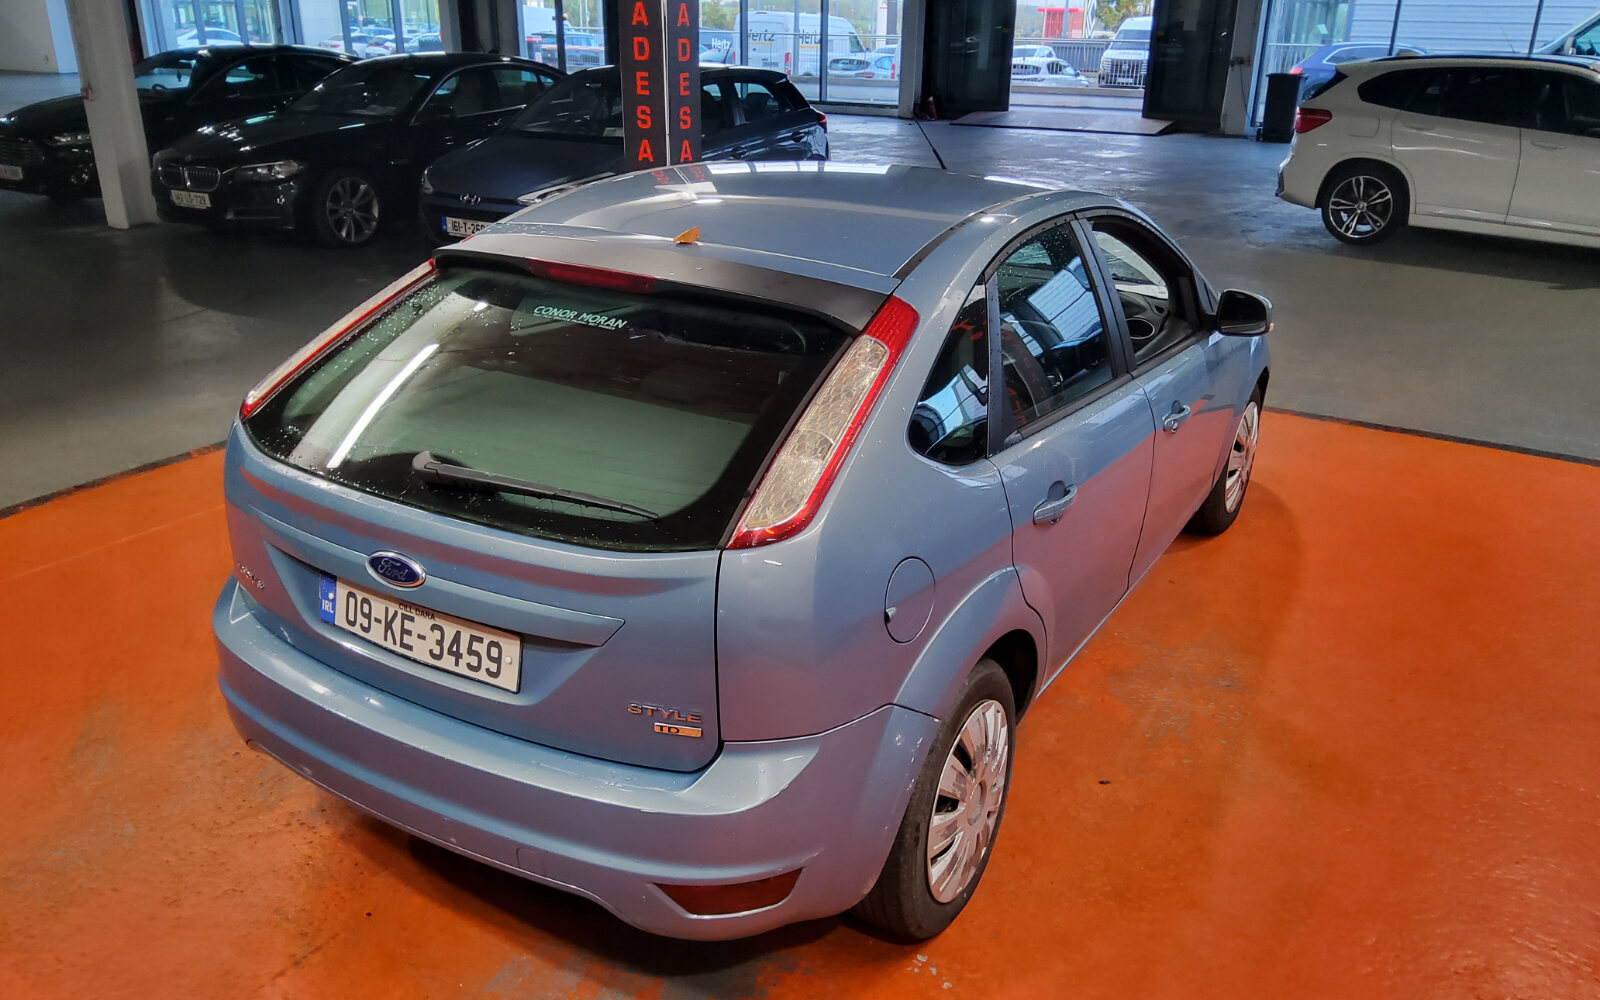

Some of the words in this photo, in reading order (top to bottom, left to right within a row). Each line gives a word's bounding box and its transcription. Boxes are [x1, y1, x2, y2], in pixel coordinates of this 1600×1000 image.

[711, 37, 732, 50] Hertz
[632, 1, 654, 163] ADESA
[677, 2, 693, 163] ADESA
[533, 305, 578, 319] CONOR
[578, 312, 628, 329] MORAN
[378, 557, 409, 582] Ford
[321, 599, 335, 614] IRL
[398, 602, 414, 614] CILL
[415, 607, 436, 621] DARA
[345, 590, 503, 679] 09-KE-3459
[627, 702, 702, 723] STYLE
